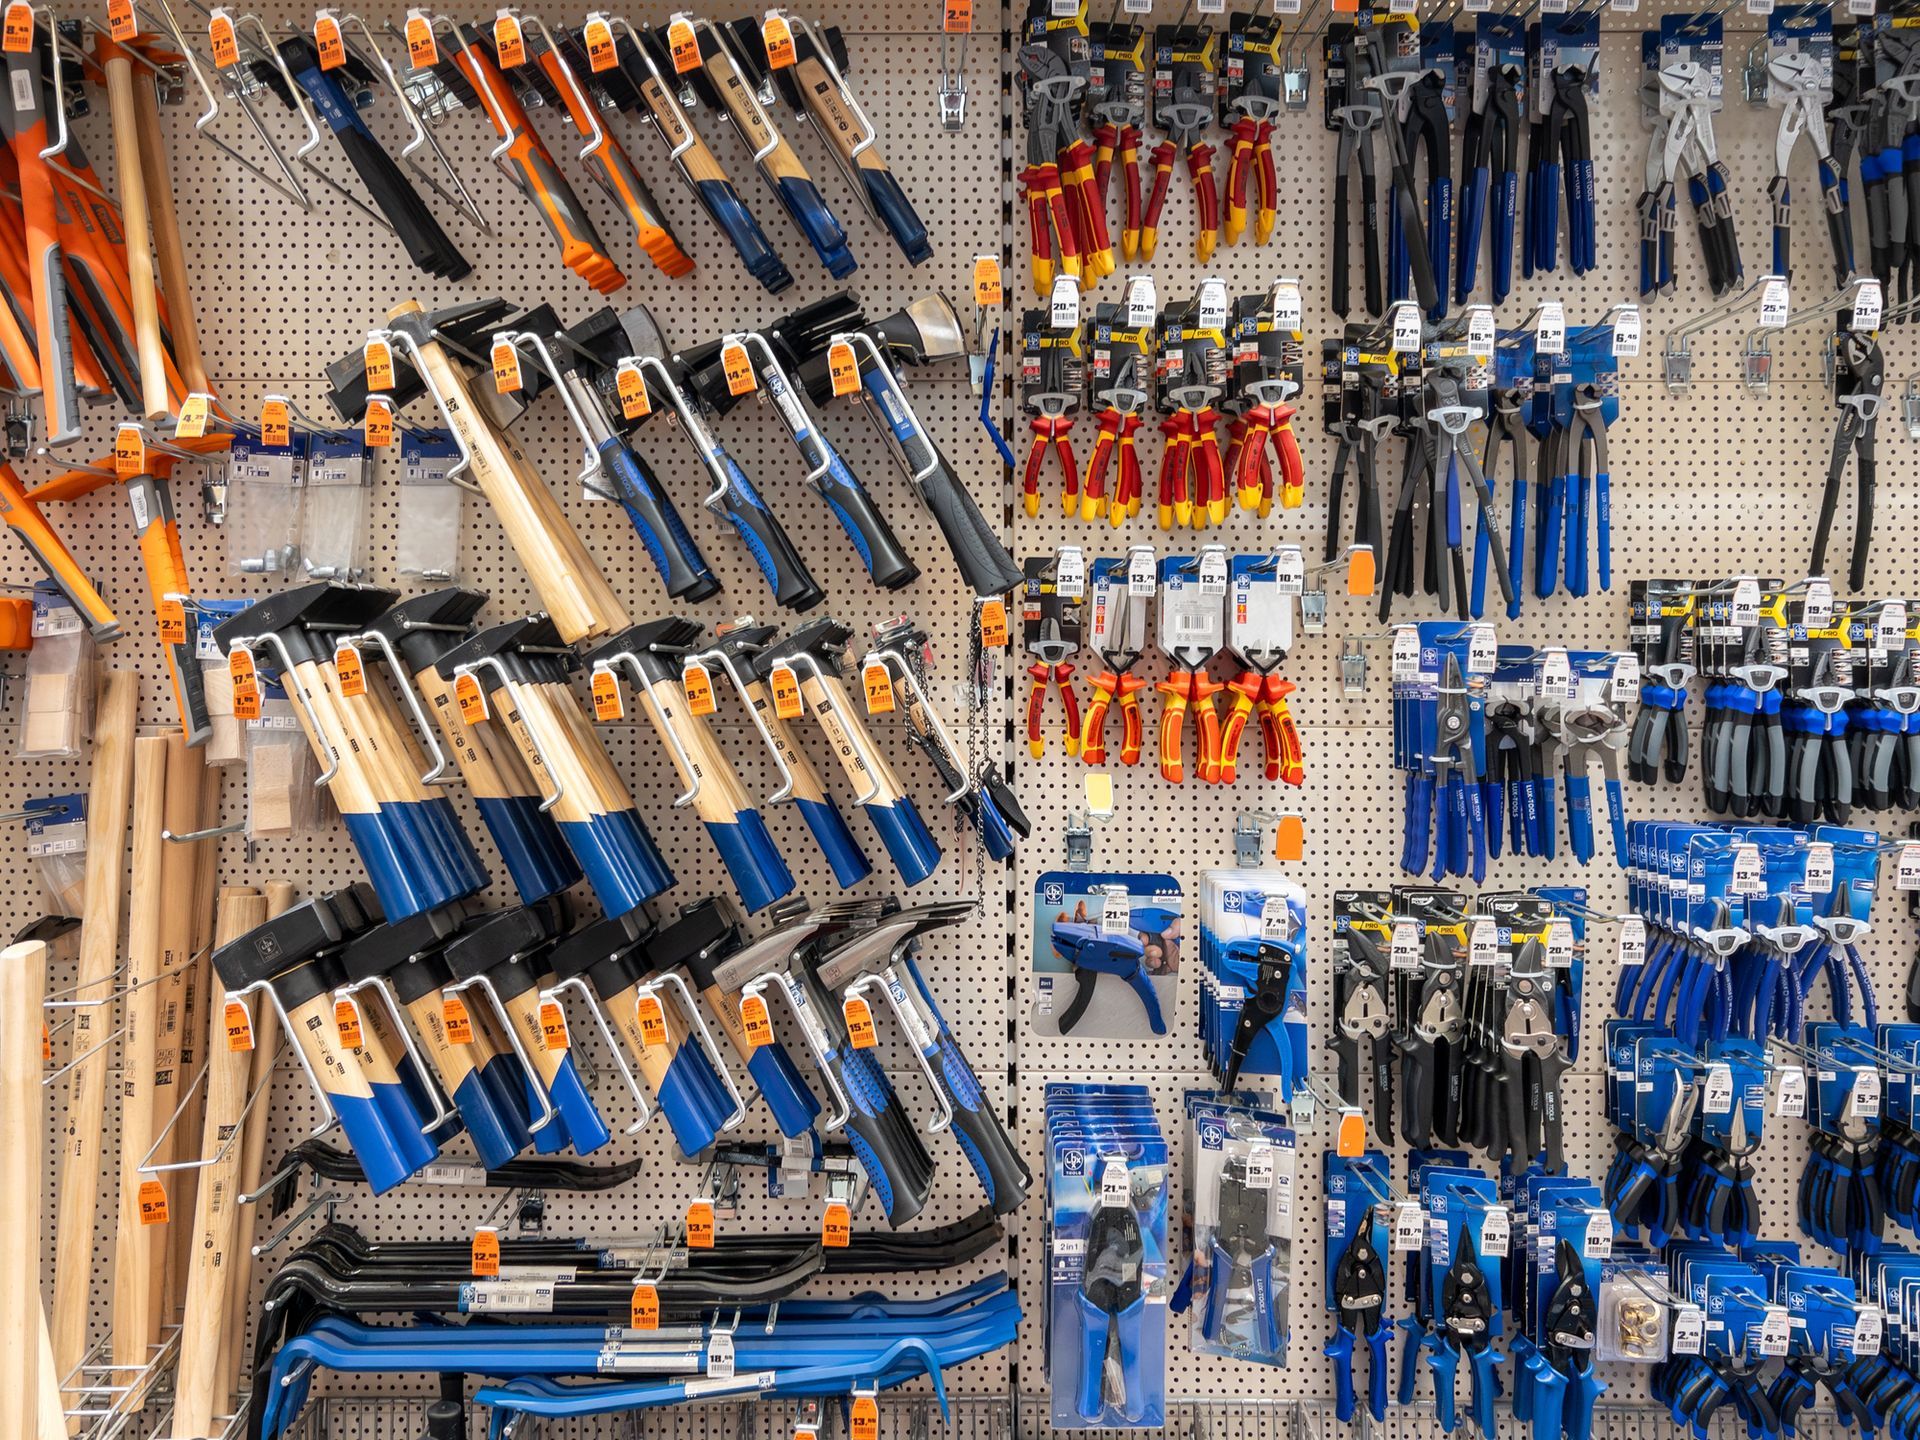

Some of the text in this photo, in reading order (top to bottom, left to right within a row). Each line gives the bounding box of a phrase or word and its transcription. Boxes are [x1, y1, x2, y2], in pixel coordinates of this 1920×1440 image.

[1389, 13, 1406, 21] PRO
[1060, 19, 1076, 27] PRO
[979, 281, 1001, 291] 4,70
[1275, 309, 1299, 319] 21,95
[1124, 334, 1138, 342] PRO
[1469, 332, 1493, 341] 16,95
[1540, 329, 1562, 340] 8,30
[1615, 333, 1638, 343] 6,45
[368, 423, 389, 434] 2,70
[1131, 573, 1155, 583] 13,75
[1201, 574, 1225, 584] 13,75
[1278, 573, 1302, 583] 10,95
[161, 619, 182, 630] 2,75
[1265, 917, 1286, 927] 7,45
[1621, 941, 1645, 950] 12,75
[1710, 1090, 1730, 1099] 7,35
[1248, 1166, 1272, 1175] 15,75
[142, 1201, 165, 1213] 5,50
[1587, 1236, 1611, 1246] 10,75
[1677, 1330, 1699, 1340] 2,45
